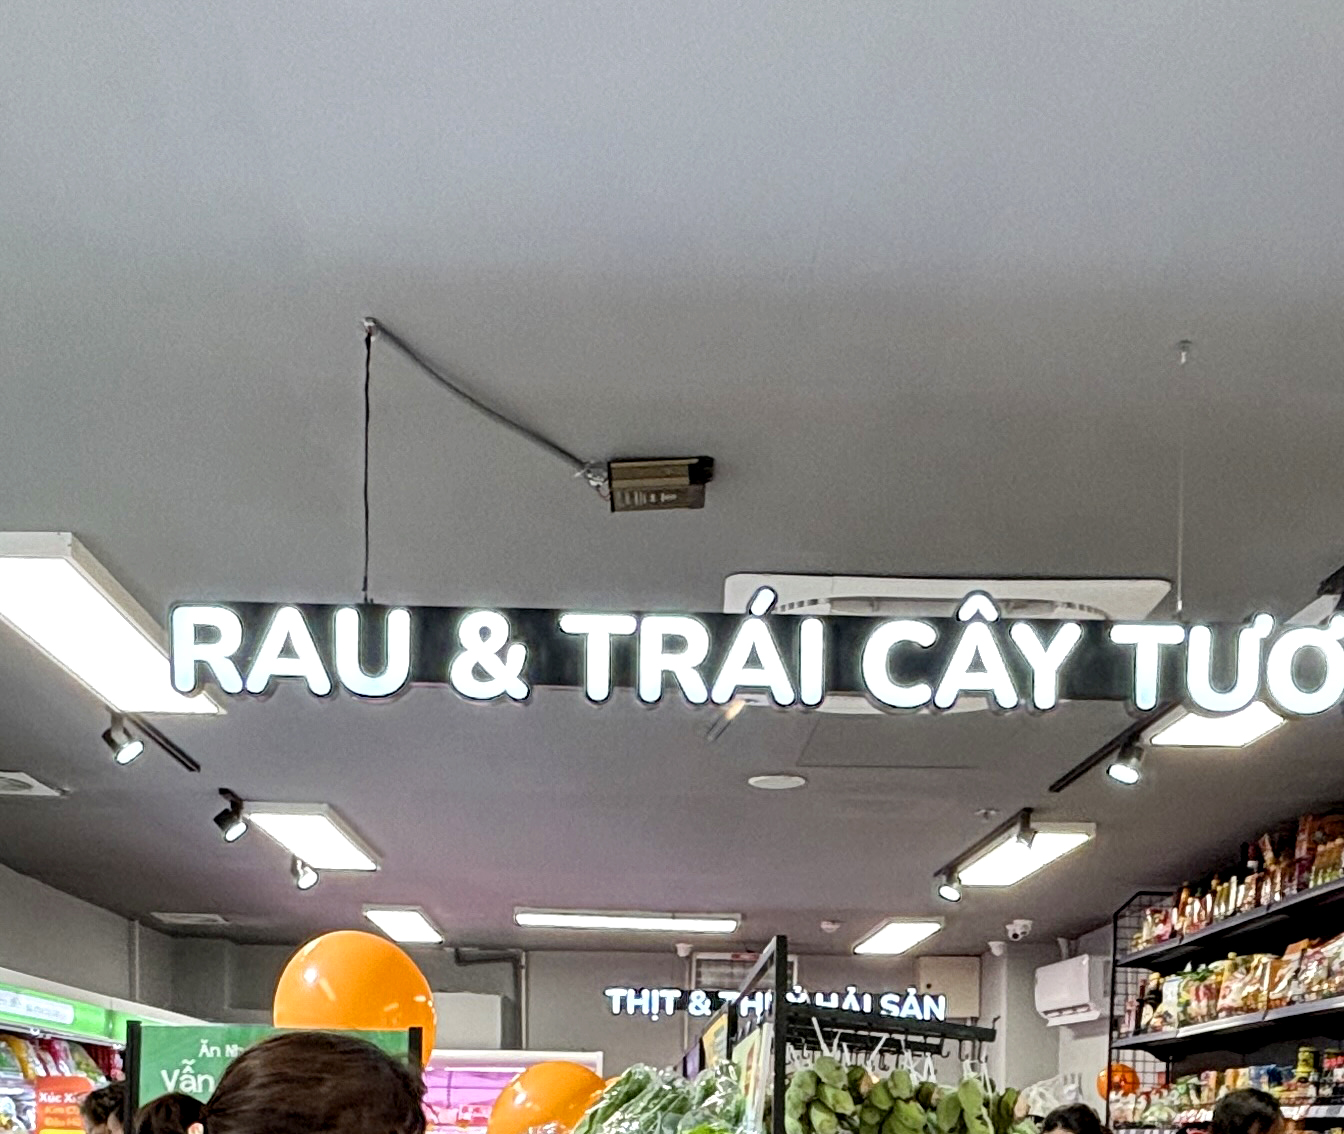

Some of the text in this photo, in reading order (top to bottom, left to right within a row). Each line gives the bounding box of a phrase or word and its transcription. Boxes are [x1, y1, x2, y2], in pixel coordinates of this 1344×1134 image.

[171, 605, 411, 698] RAU
[449, 608, 529, 700] &
[559, 588, 824, 706] TRÁI
[861, 592, 1083, 710] CÂY
[605, 986, 683, 1021] THỊT
[687, 989, 713, 1017] &
[879, 985, 947, 1021] SẢN
[198, 1039, 222, 1058] Ăn
[160, 1059, 216, 1094] Vẫn
